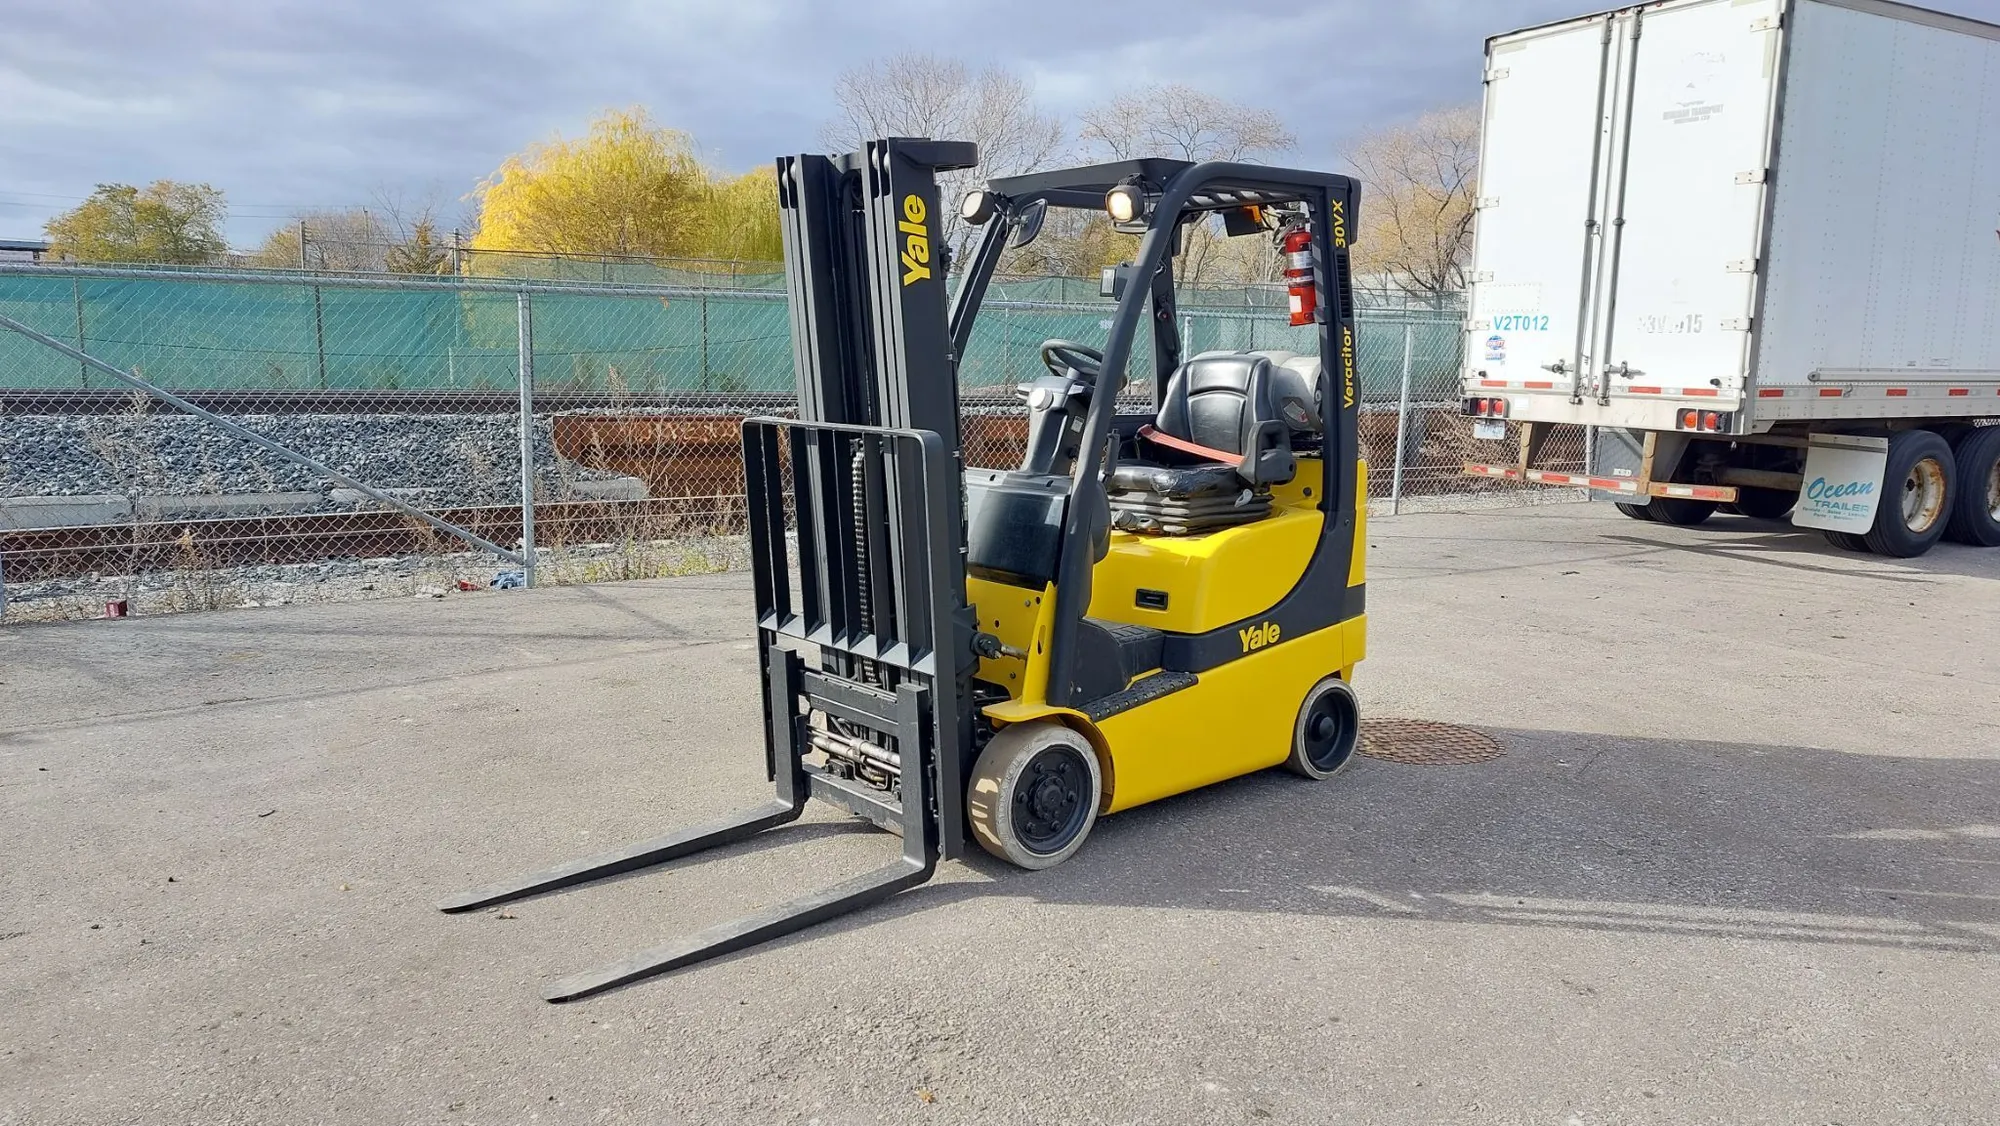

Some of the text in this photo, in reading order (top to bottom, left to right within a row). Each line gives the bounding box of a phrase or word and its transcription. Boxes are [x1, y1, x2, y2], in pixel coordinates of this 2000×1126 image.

[1332, 199, 1346, 249] 30VX
[898, 194, 931, 287] Yale
[1494, 315, 1549, 331] V2T012
[1341, 326, 1354, 409] Veracitor
[1807, 477, 1873, 499] Ocean
[1814, 500, 1869, 512] TRAILER
[1239, 621, 1280, 653] Yale
